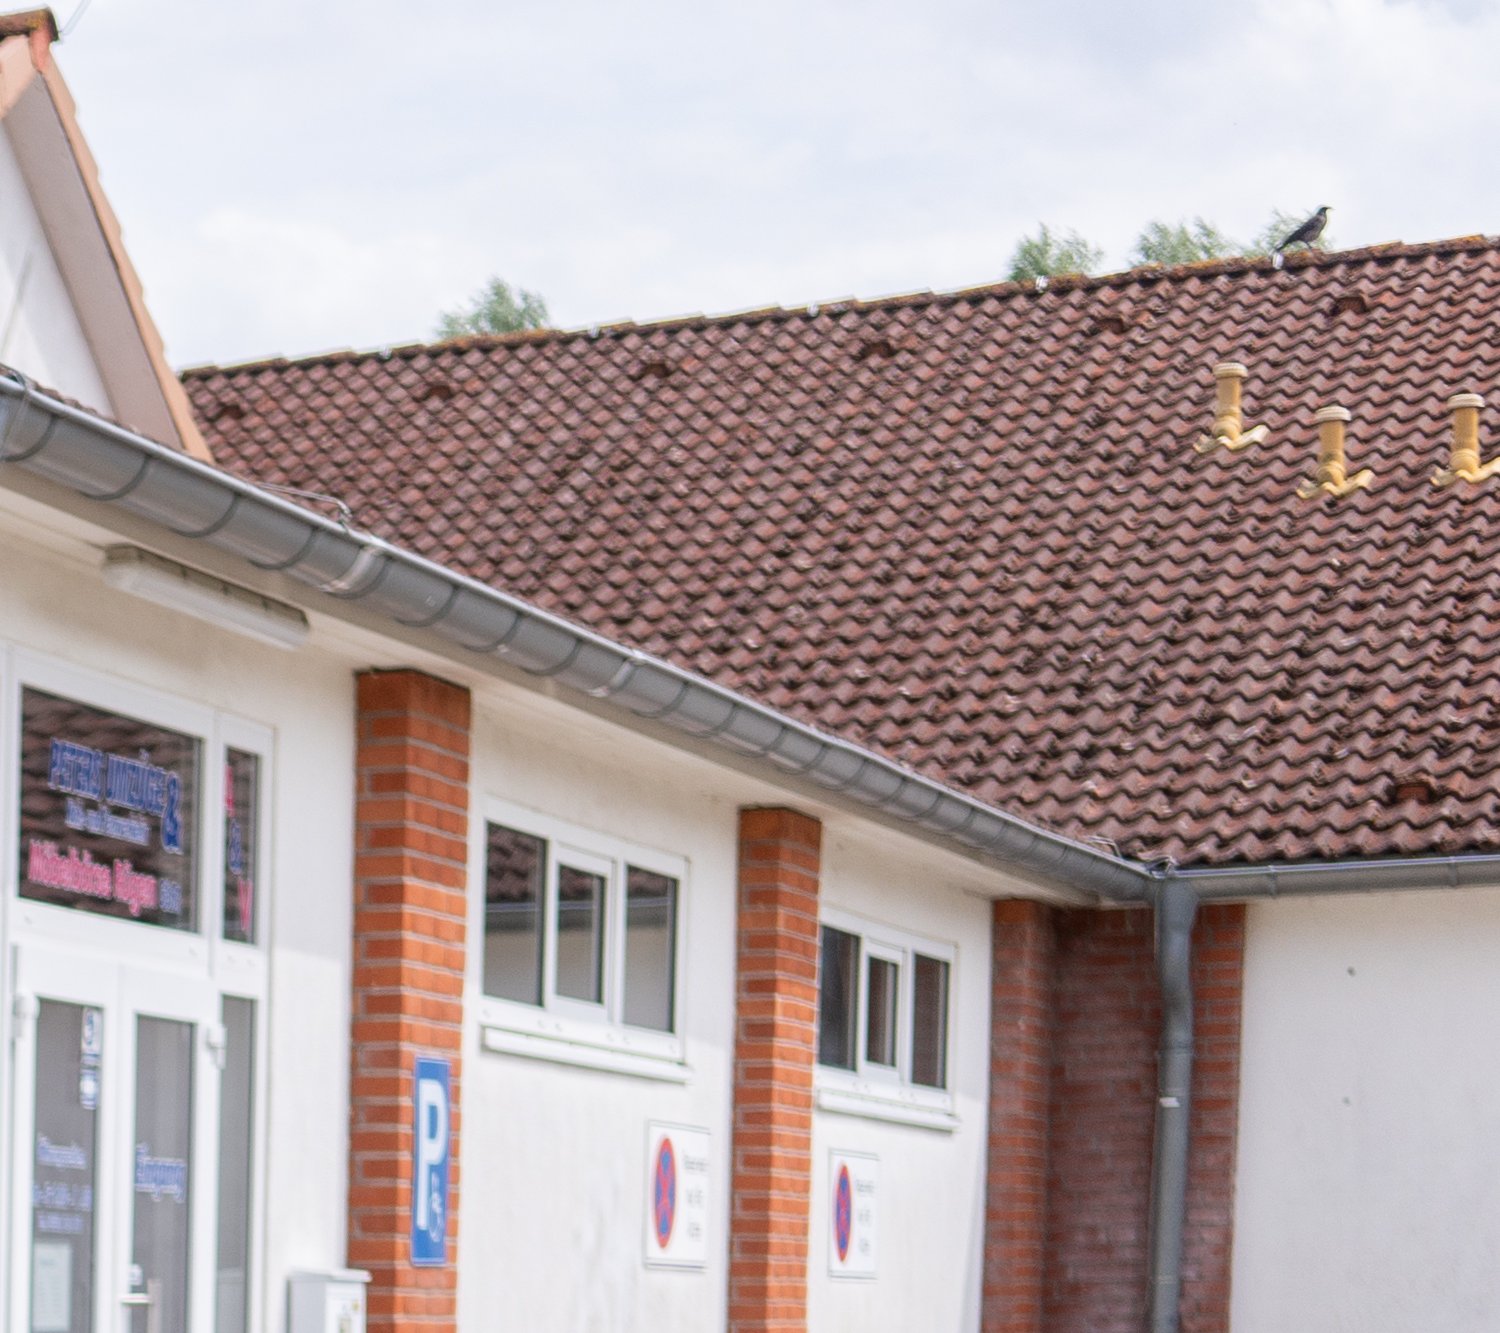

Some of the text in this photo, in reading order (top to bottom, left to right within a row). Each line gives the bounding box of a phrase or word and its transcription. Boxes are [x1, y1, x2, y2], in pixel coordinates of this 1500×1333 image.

[48, 738, 103, 802] PETERS
[161, 770, 184, 855] &
[416, 1078, 449, 1231] P
